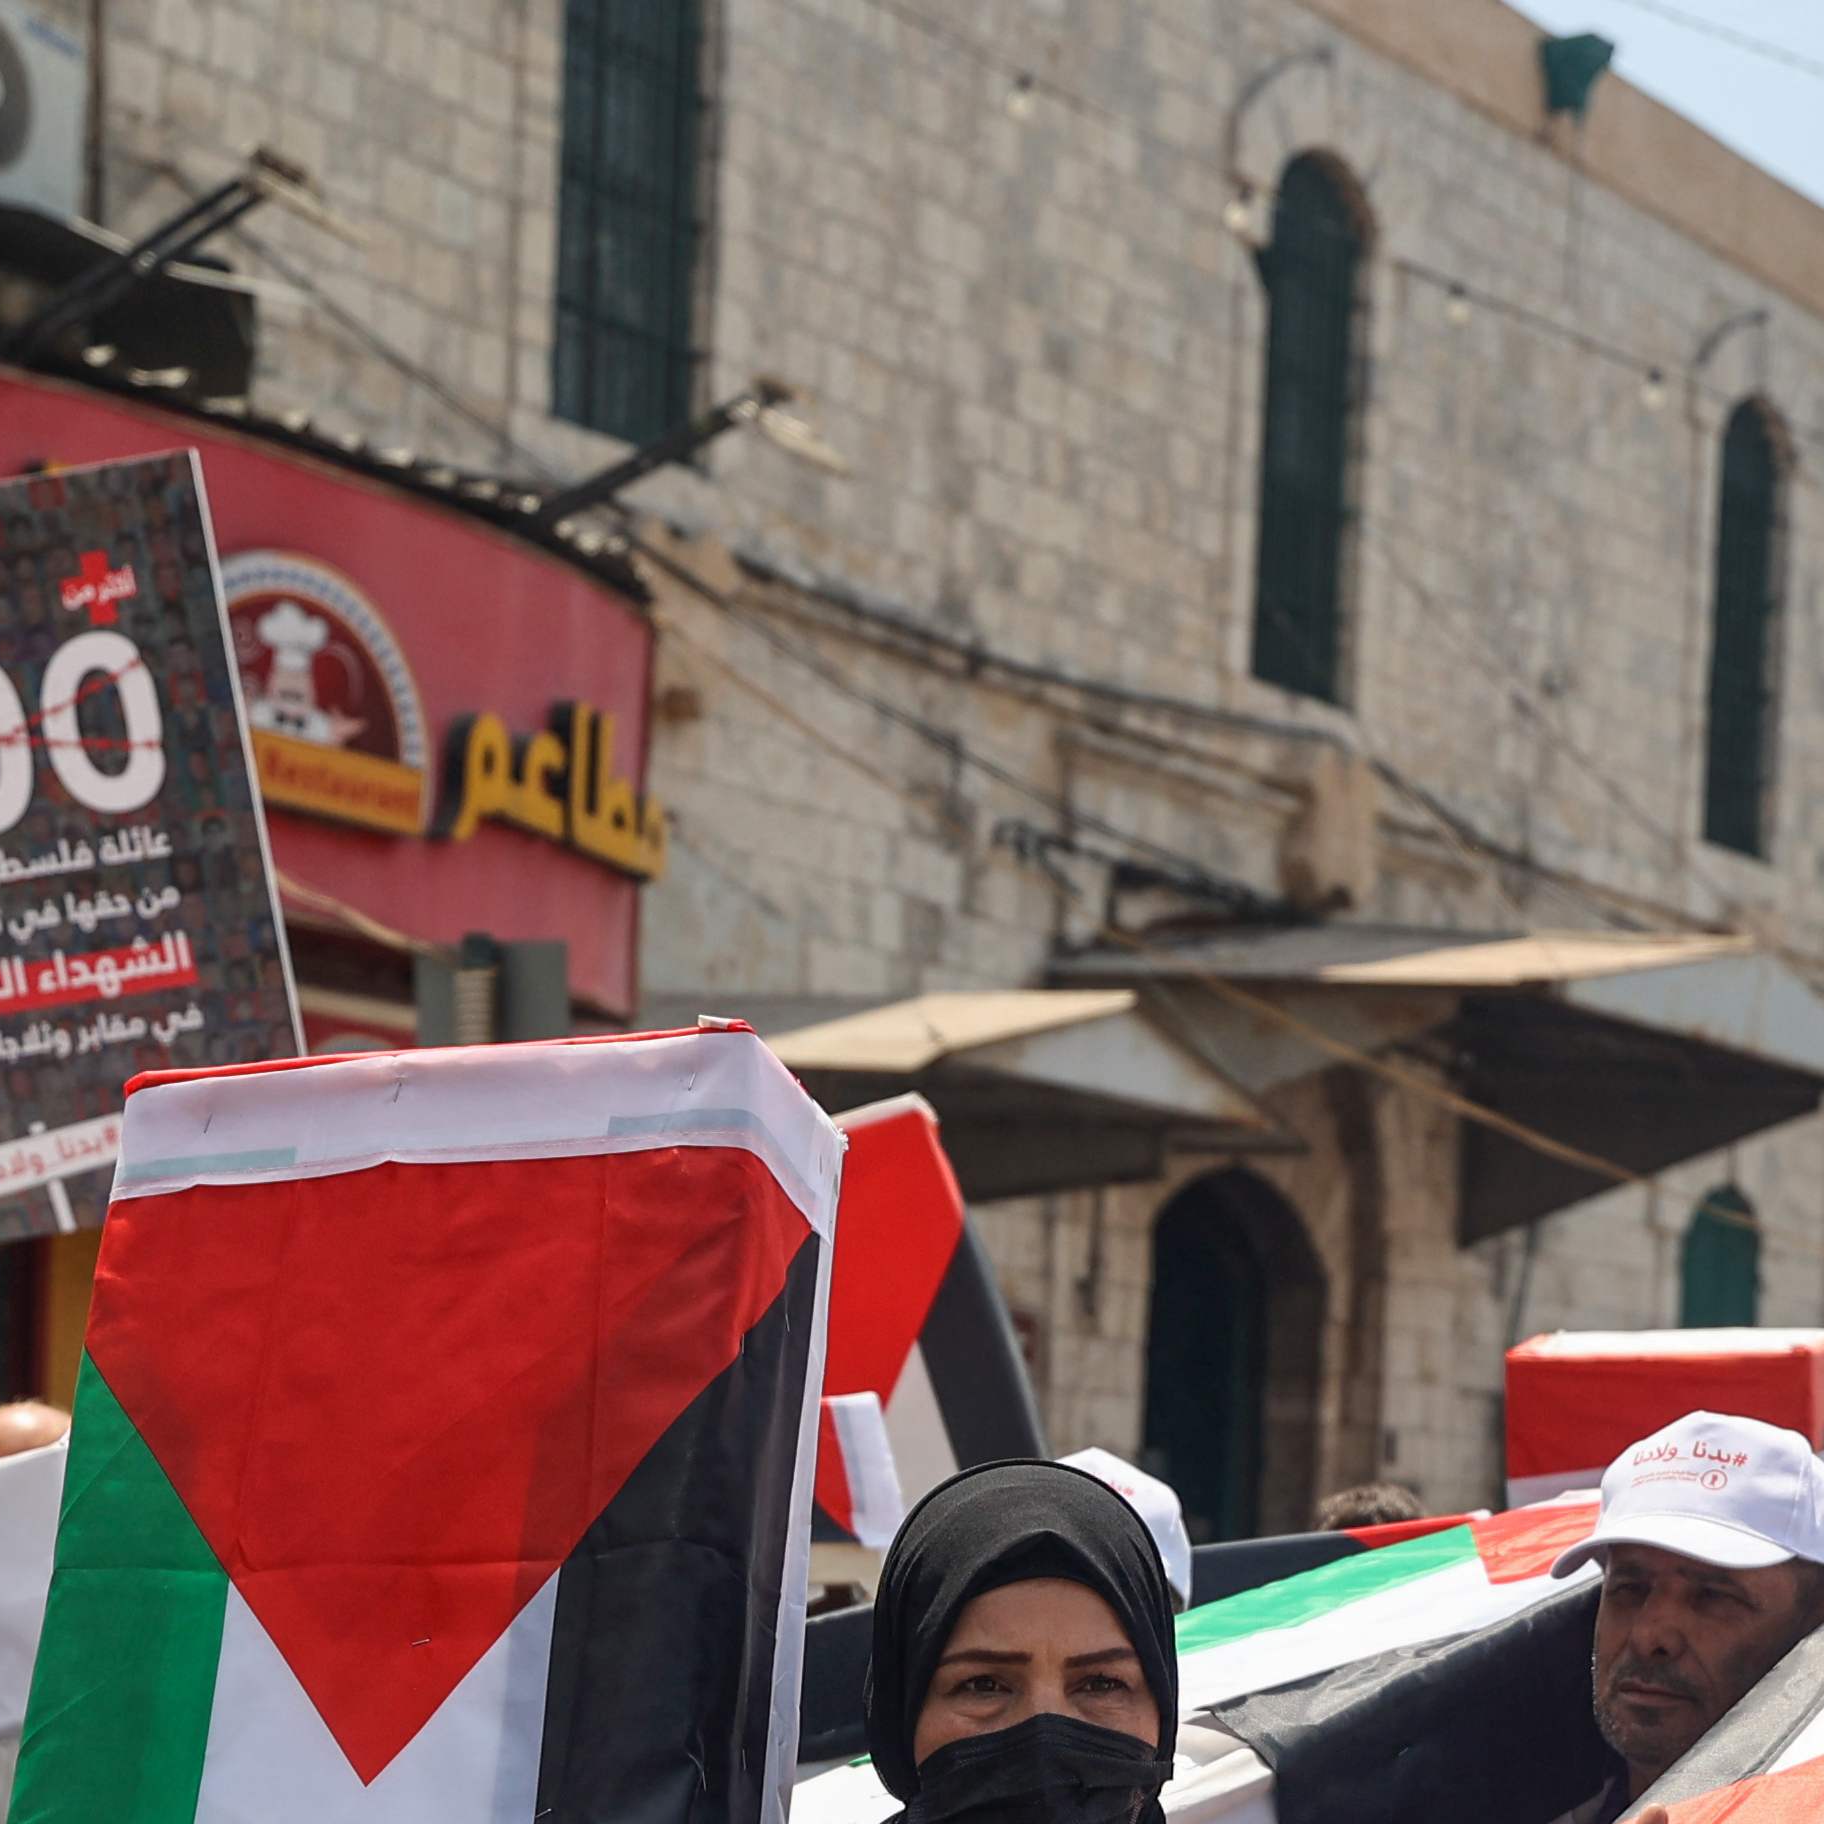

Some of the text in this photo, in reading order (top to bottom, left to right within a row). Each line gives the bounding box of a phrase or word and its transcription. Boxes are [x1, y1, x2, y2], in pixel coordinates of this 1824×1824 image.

[99, 824, 173, 865] عائلة
[7, 899, 60, 941] في
[67, 891, 132, 931] حقها
[139, 884, 181, 919] من
[37, 930, 192, 998] الشهداء
[76, 1012, 146, 1055] مقابر
[150, 1001, 205, 1044] في
[1633, 1440, 1749, 1469] #بدنا_ولادنا
